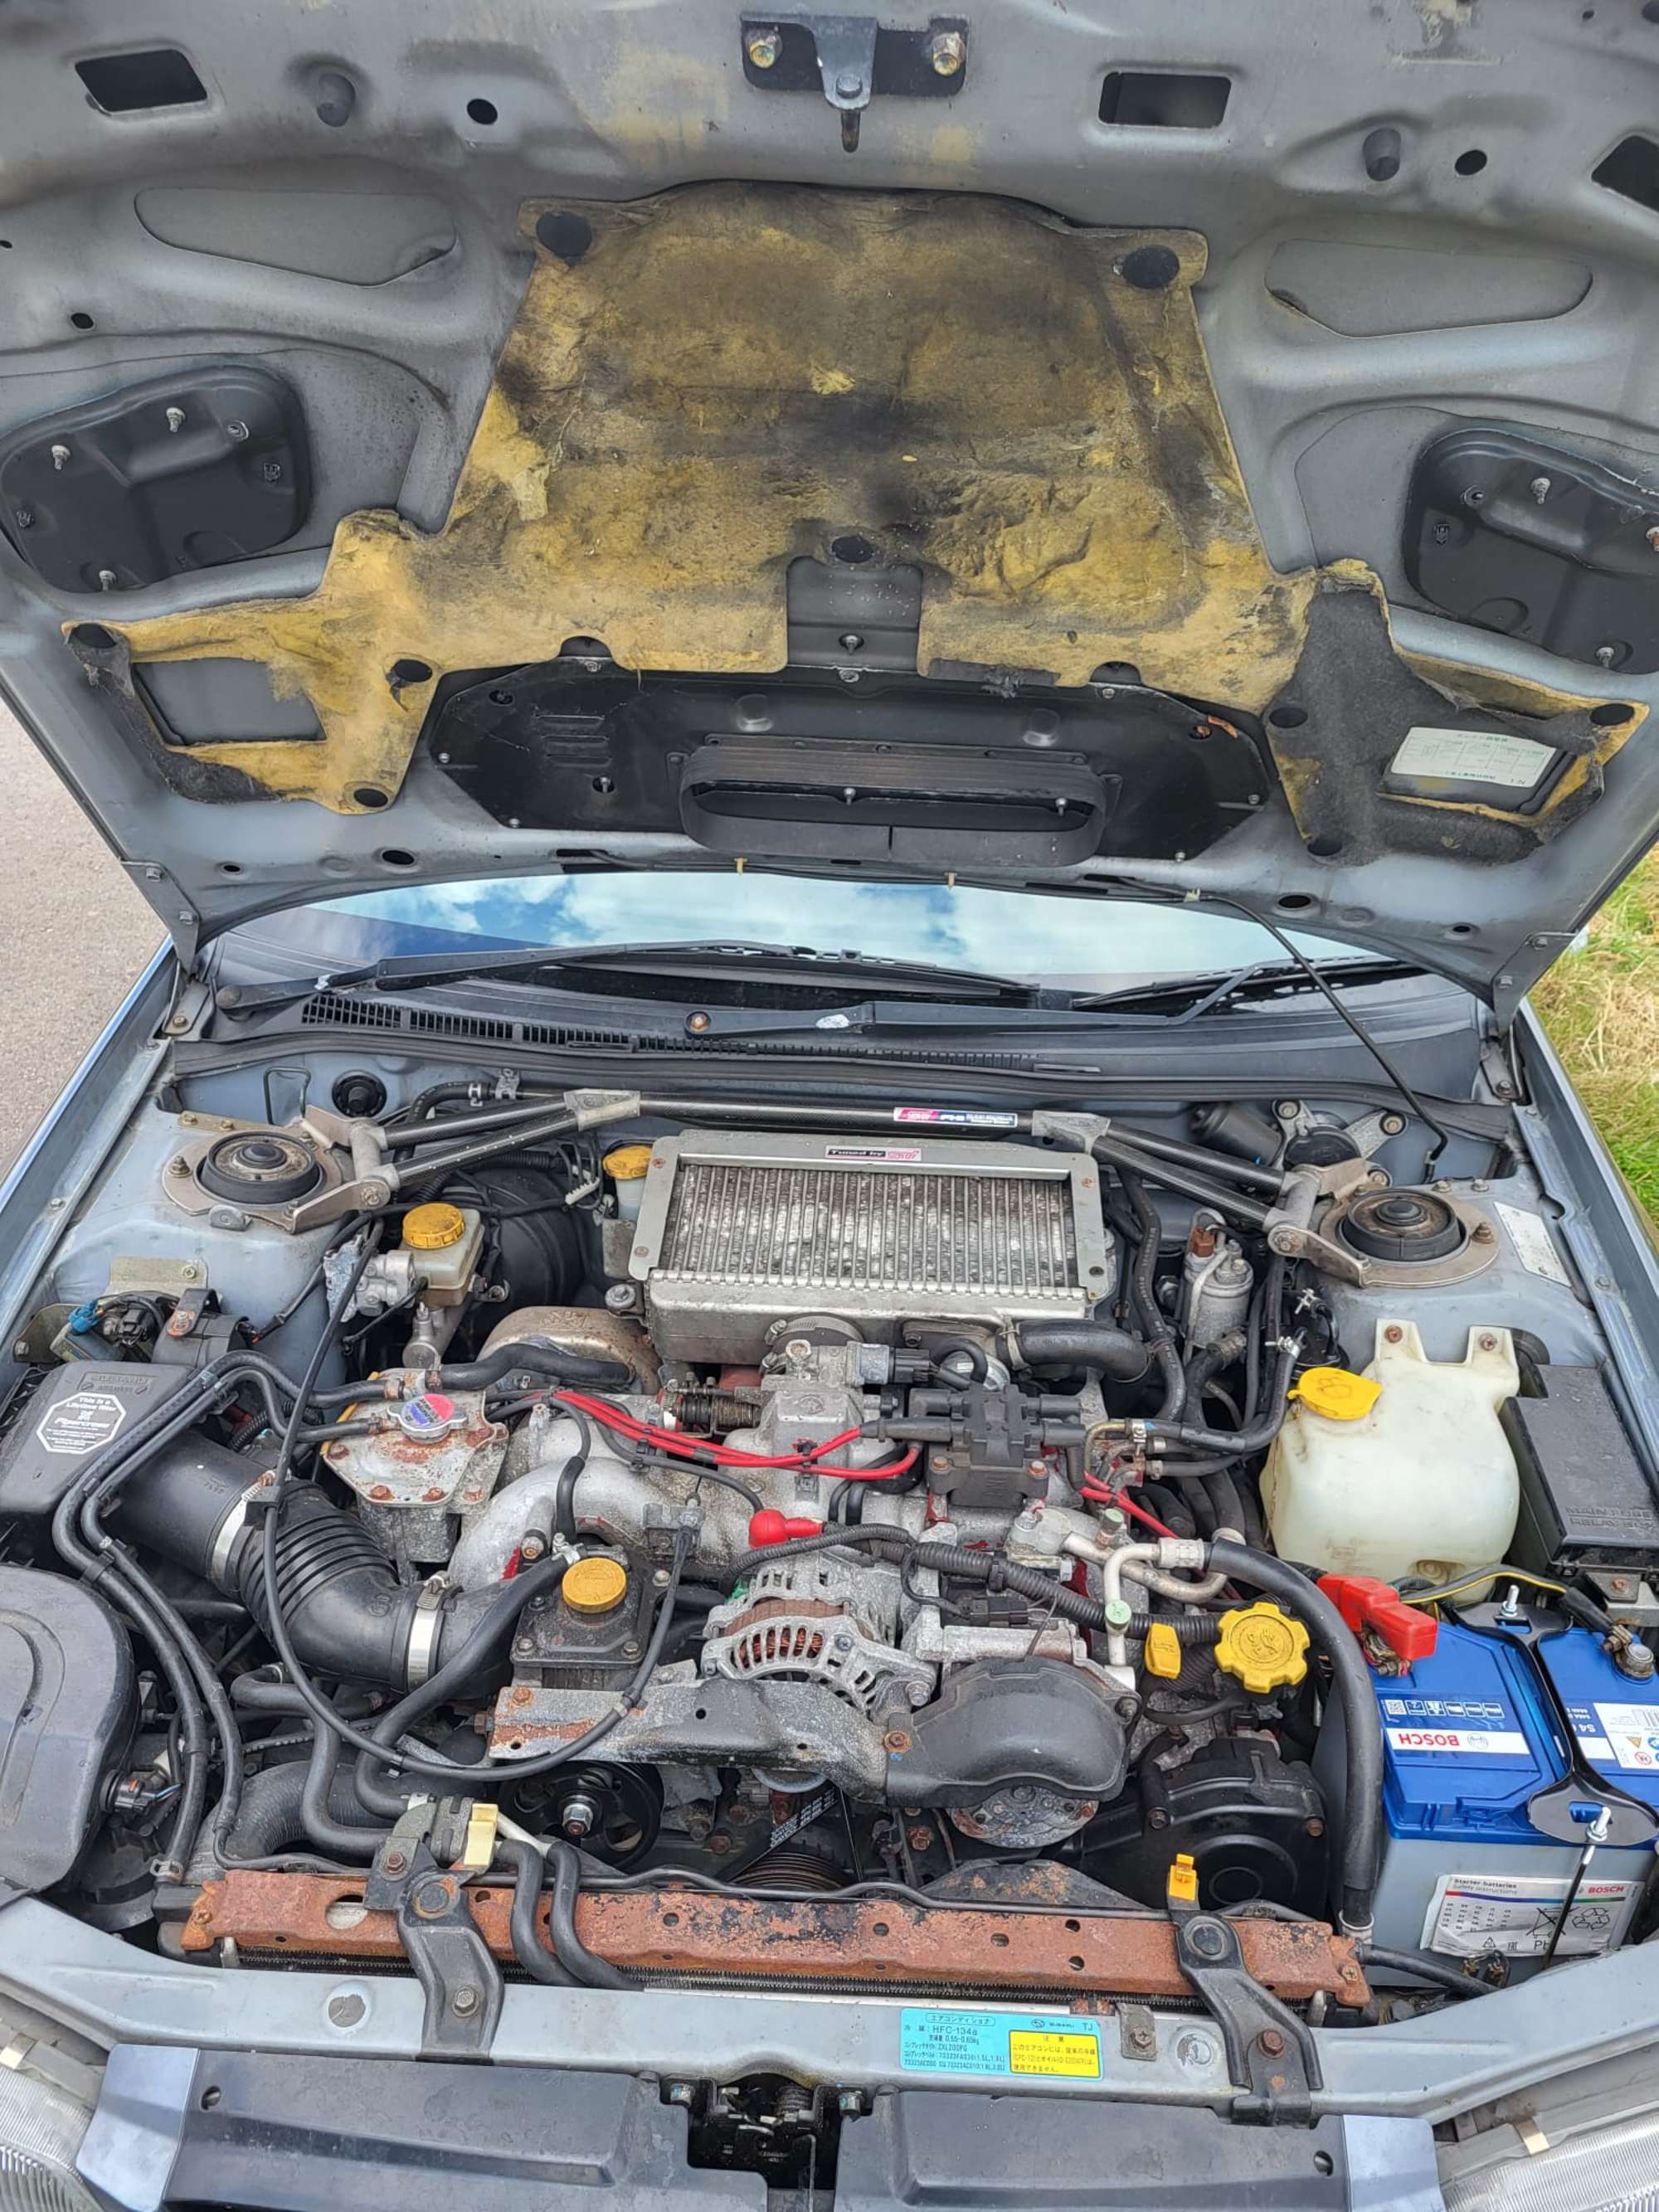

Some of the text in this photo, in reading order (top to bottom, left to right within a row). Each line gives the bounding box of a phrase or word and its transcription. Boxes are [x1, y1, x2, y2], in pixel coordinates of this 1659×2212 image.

[1398, 1733, 1461, 1747] BOSCH
[1453, 1878, 1517, 1889] Starter batteries
[1588, 1885, 1625, 1895] BOSCH
[932, 2025, 978, 2036] HFC-134a
[1082, 2022, 1093, 2031] TJ
